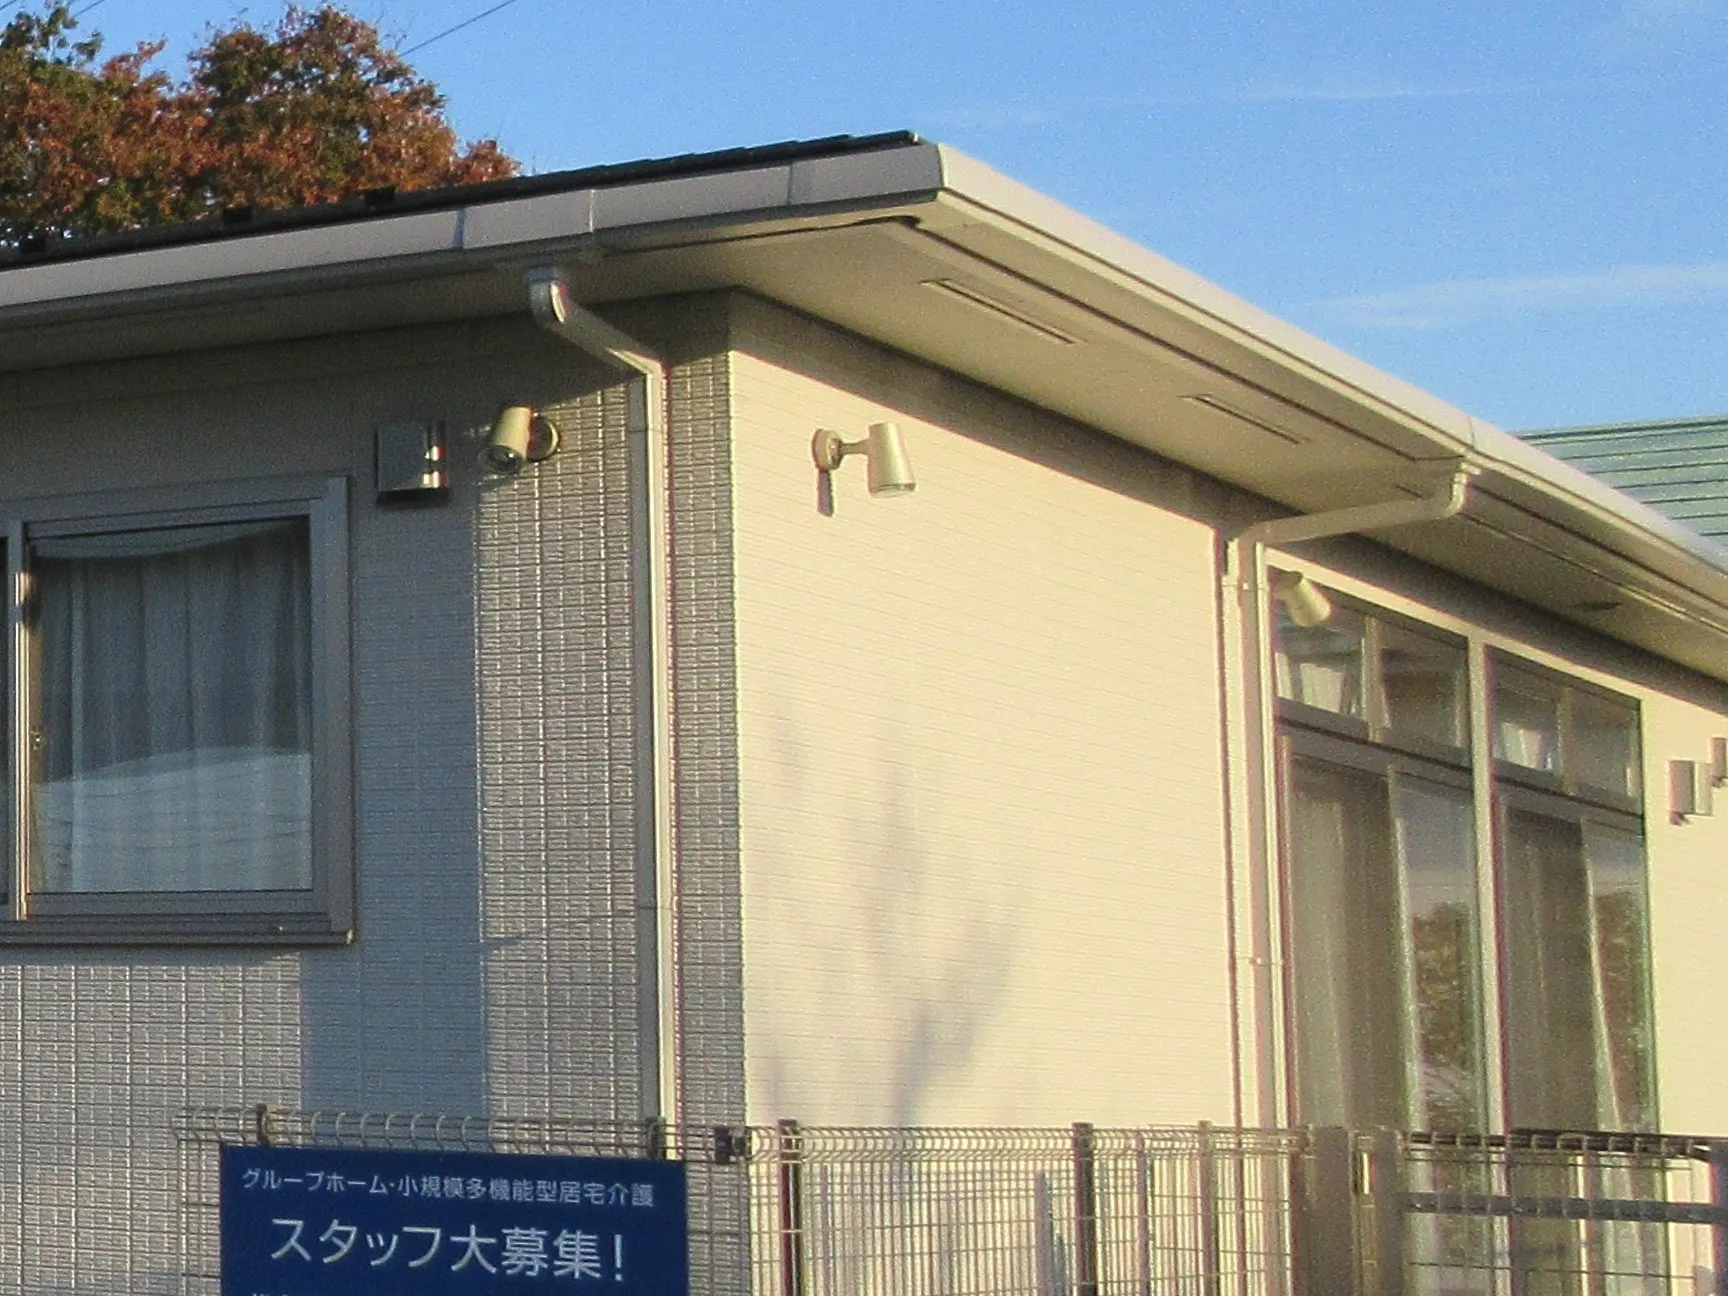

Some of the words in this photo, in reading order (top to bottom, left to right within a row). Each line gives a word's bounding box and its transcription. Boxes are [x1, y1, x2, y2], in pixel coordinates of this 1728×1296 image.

[270, 1217, 625, 1282] スタッフ大募集!
